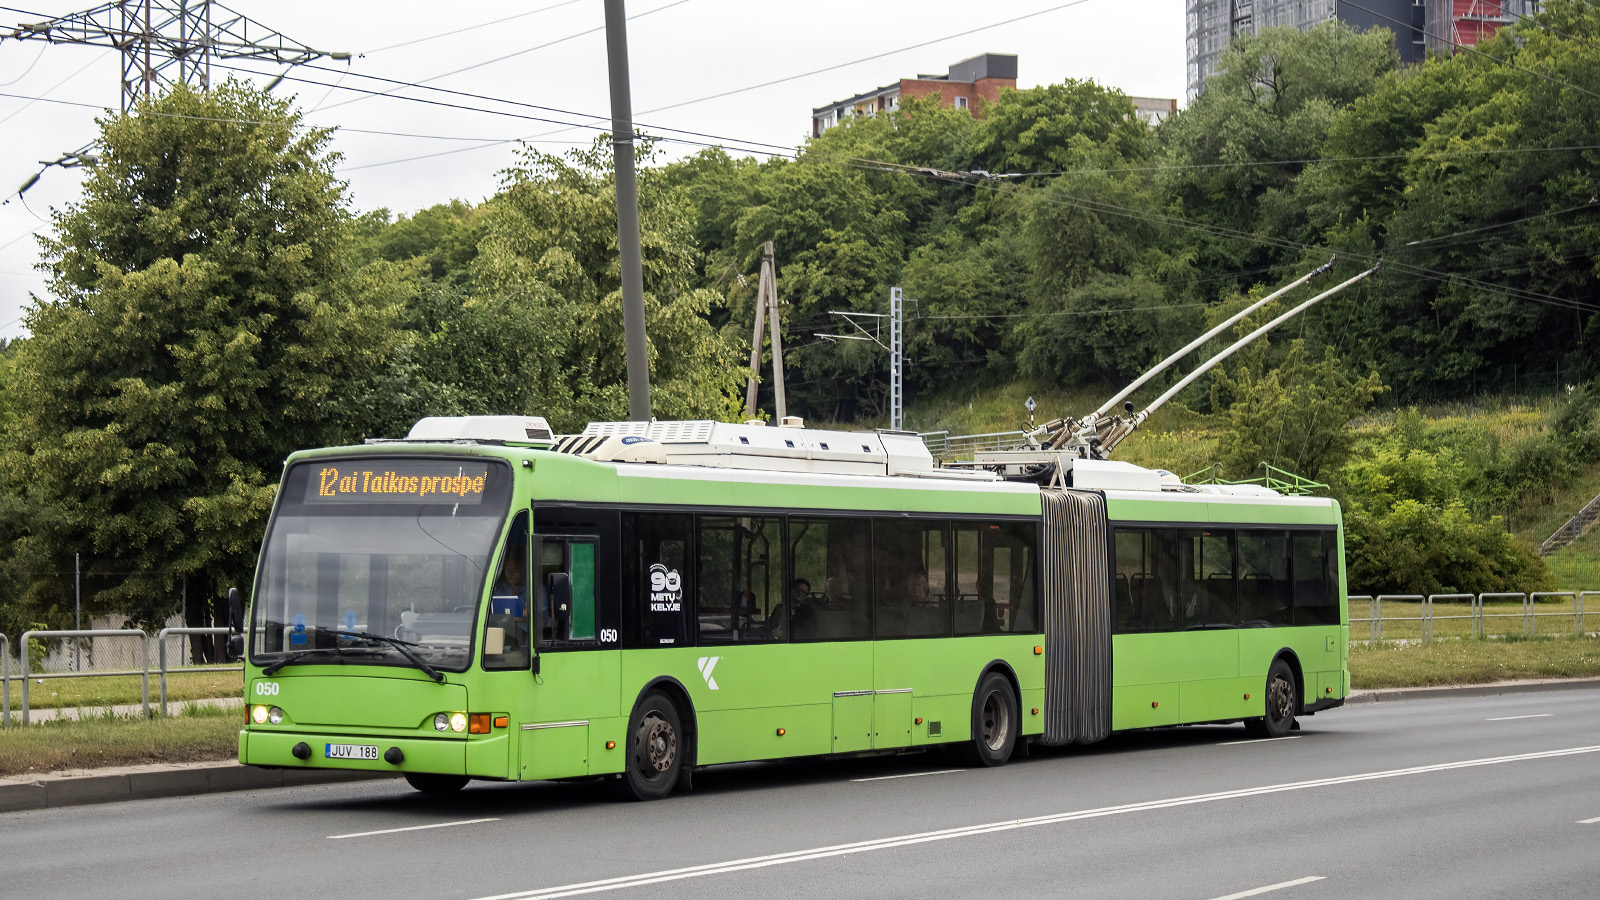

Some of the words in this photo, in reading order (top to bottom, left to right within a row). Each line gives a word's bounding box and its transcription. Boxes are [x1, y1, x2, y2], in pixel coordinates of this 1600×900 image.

[319, 468, 339, 496] 12
[339, 471, 358, 493] ai
[362, 471, 419, 493] Taikos
[419, 471, 488, 496] prospe
[651, 571, 681, 592] 90
[651, 603, 681, 612] KELYJE
[600, 629, 618, 643] 050
[256, 682, 280, 696] 050
[331, 745, 353, 757] JUV
[360, 746, 377, 758] 188
